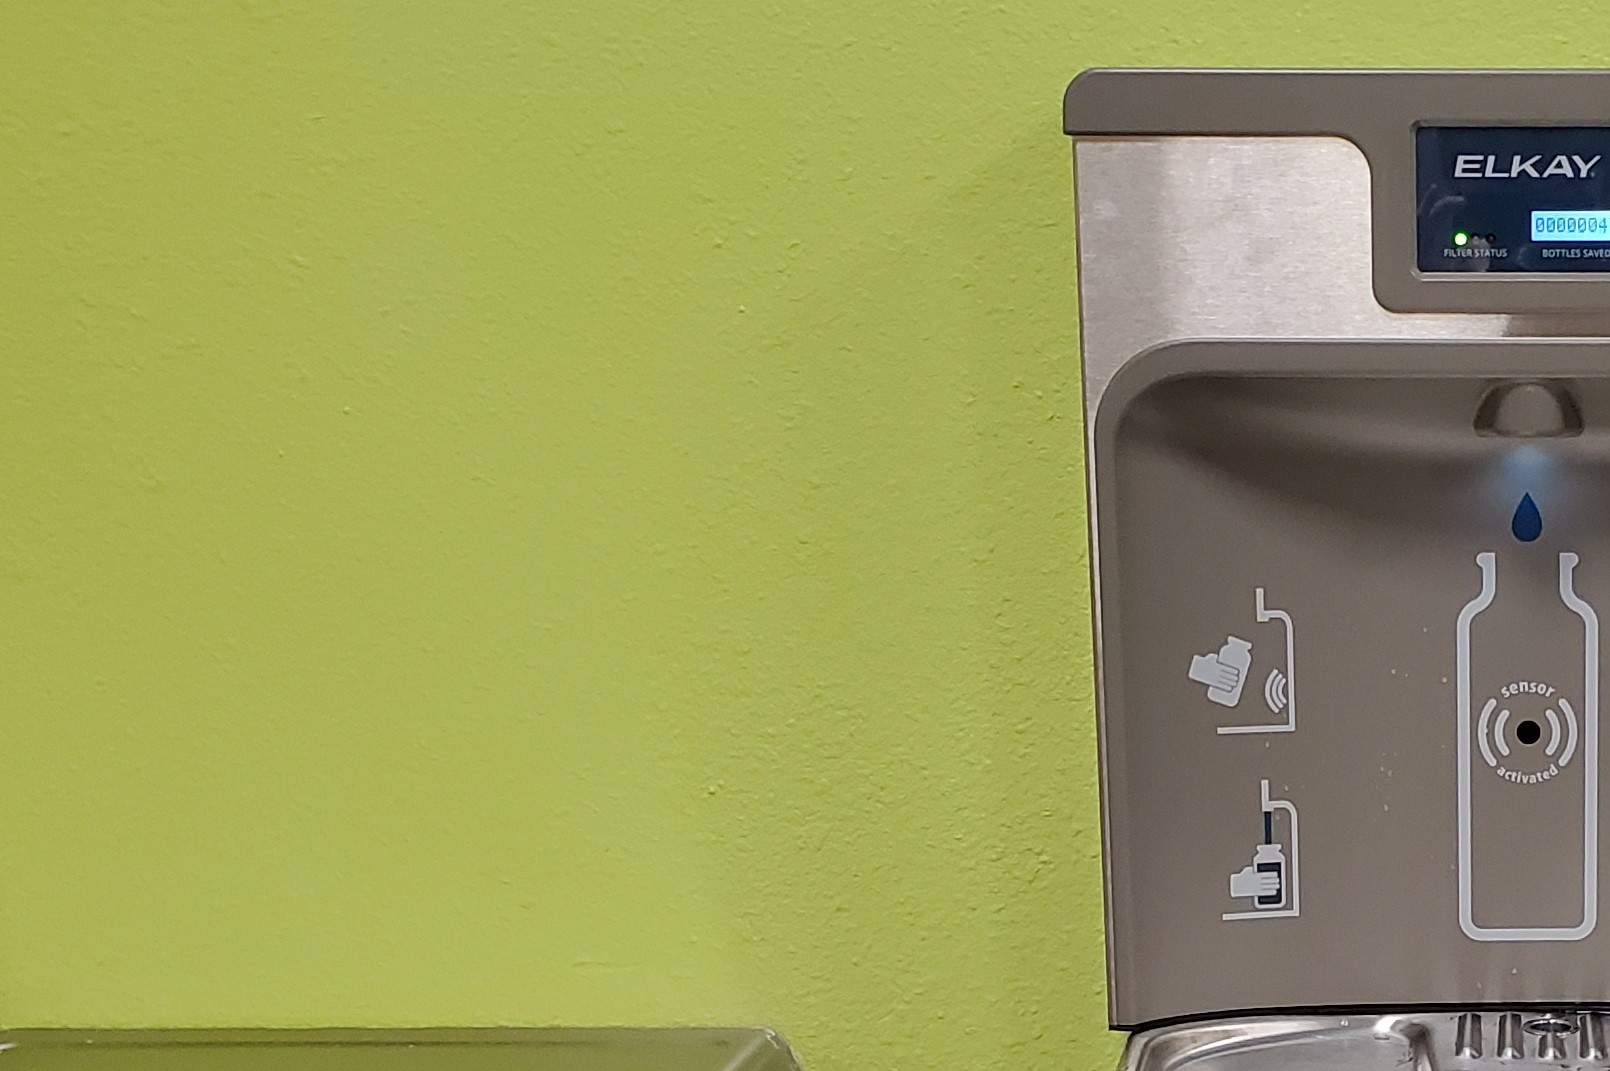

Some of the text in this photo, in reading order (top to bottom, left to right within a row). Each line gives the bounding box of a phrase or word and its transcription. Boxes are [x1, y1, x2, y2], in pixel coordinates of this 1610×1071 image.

[1454, 154, 1601, 178] ELKAY
[1443, 248, 1508, 258] FILTER STATUS
[1542, 248, 1581, 258] BOTTLES
[1501, 681, 1556, 698] sensor
[1496, 763, 1559, 784] activated
